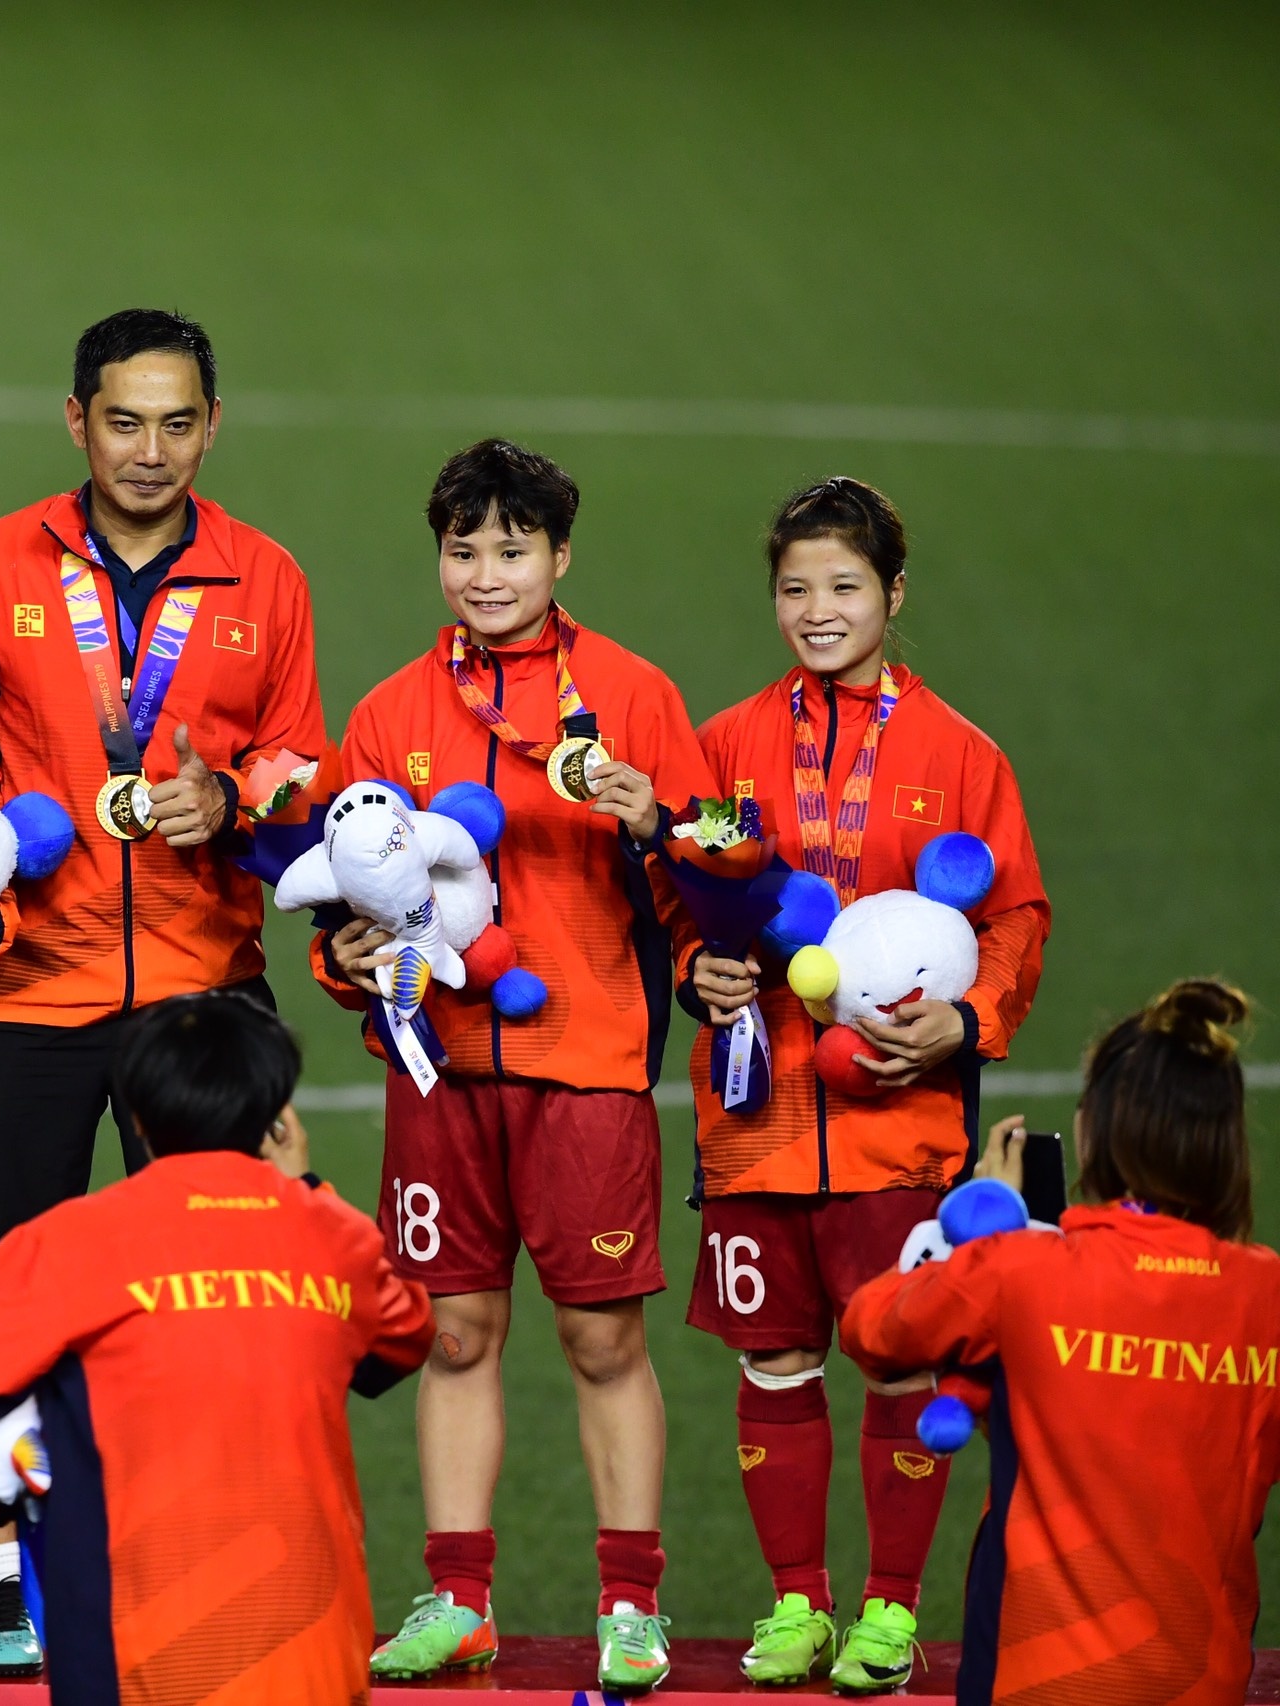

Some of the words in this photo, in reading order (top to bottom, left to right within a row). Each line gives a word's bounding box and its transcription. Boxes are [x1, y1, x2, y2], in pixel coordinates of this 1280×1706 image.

[94, 663, 107, 682] 2019
[144, 670, 162, 700] GAMES
[98, 682, 120, 733] PHILIPPINES
[138, 700, 152, 718] SEA
[405, 905, 424, 929] WE
[738, 1025, 747, 1036] WE
[414, 1059, 424, 1071] WIN
[733, 1065, 742, 1074] AS
[420, 1071, 430, 1081] WE
[732, 1074, 741, 1086] WIN
[730, 1086, 740, 1096] WE
[393, 1176, 441, 1262] 18
[707, 1231, 766, 1315] 16
[126, 1269, 353, 1321] VIETNAM
[1049, 1323, 1279, 1388] VIETNAM
